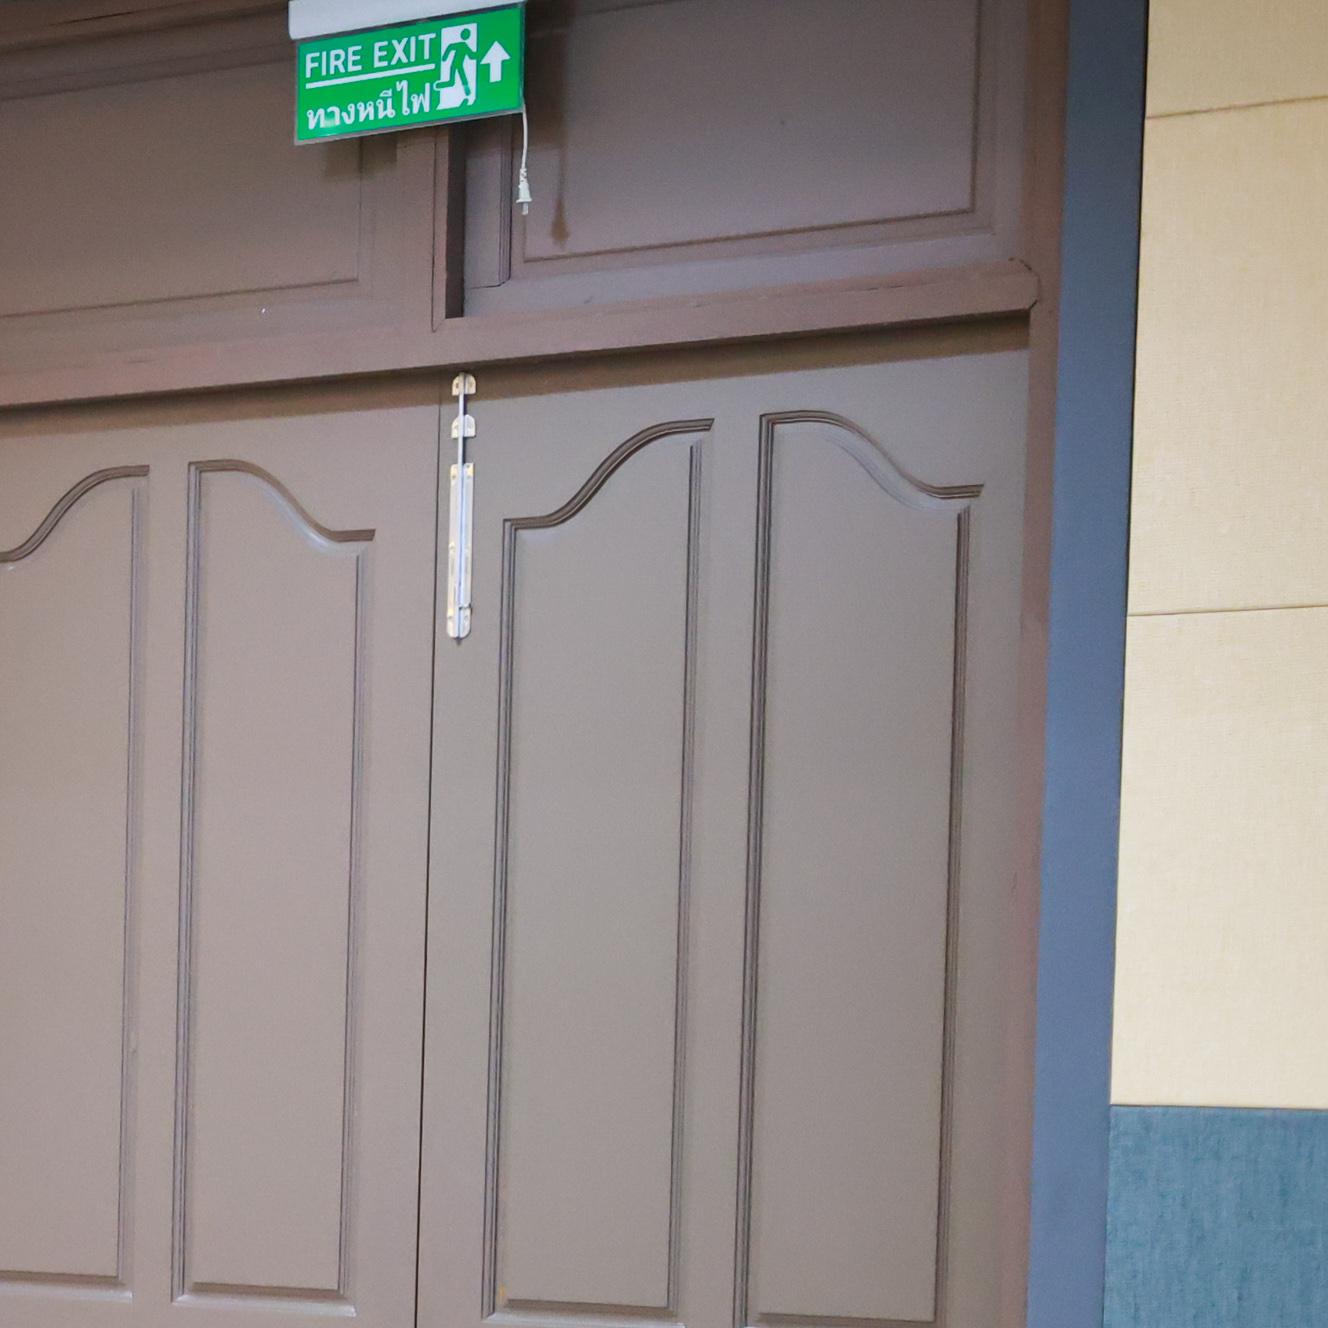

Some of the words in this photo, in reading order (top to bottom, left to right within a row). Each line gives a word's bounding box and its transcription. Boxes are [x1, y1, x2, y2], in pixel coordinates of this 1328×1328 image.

[305, 45, 362, 78] FIRE
[373, 33, 436, 68] EXIT
[306, 79, 431, 130] ทางหนีไฟ
